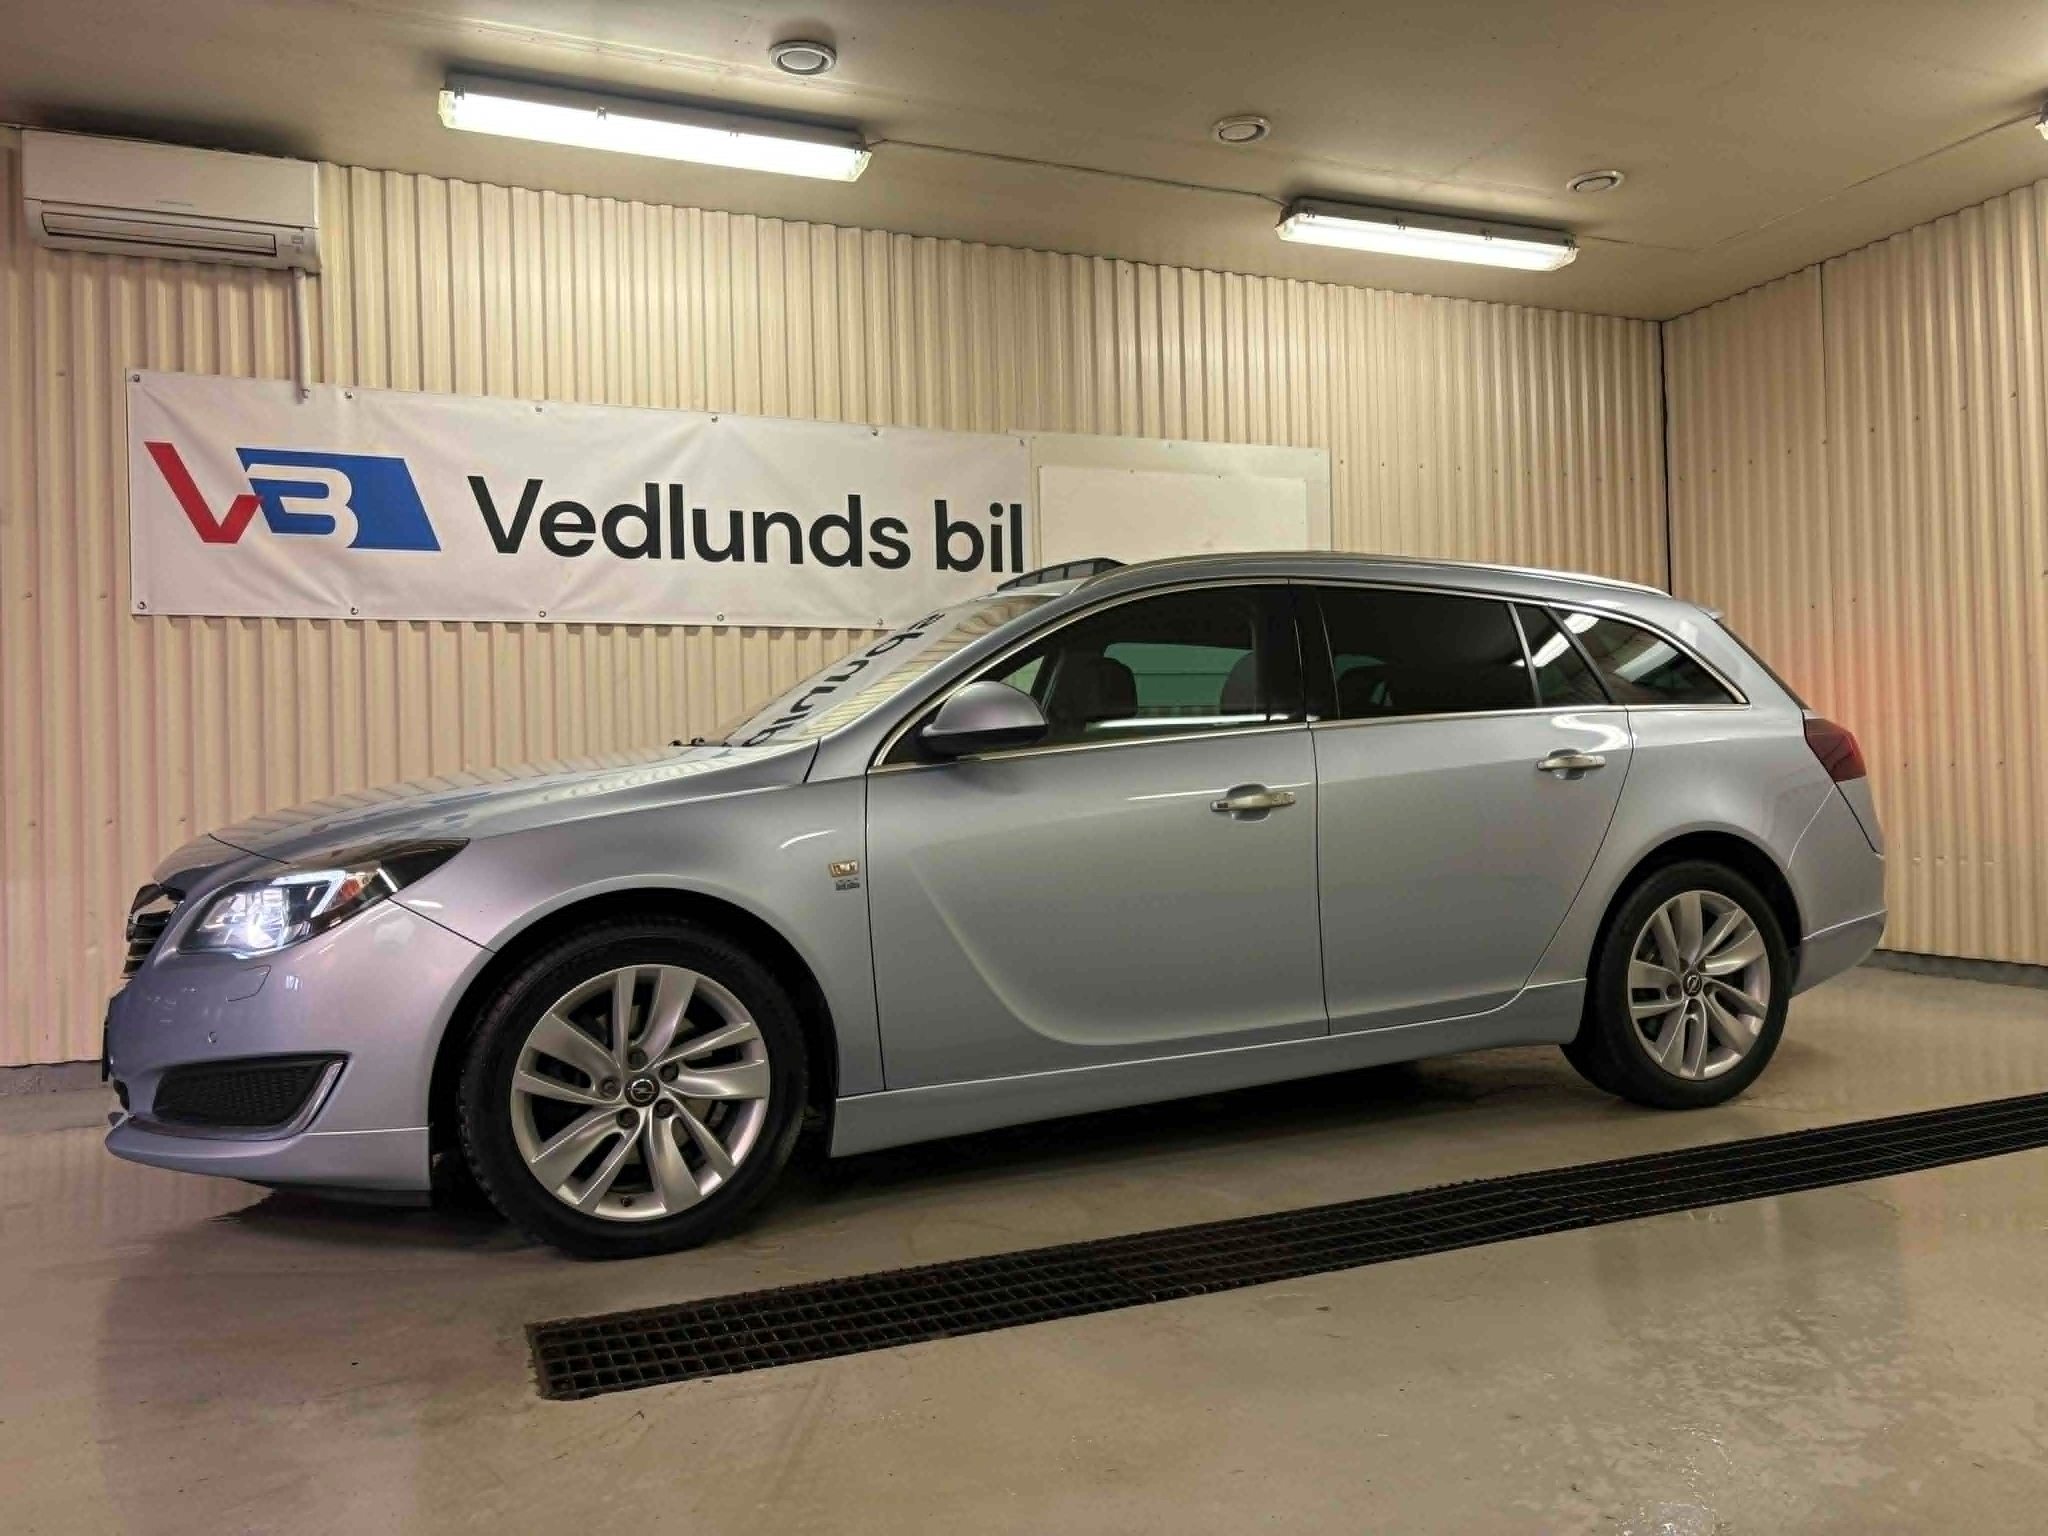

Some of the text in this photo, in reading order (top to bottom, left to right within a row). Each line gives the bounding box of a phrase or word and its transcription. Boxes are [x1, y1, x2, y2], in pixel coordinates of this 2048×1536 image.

[144, 440, 360, 549] VB
[467, 475, 1024, 575] Vedlunds bil
